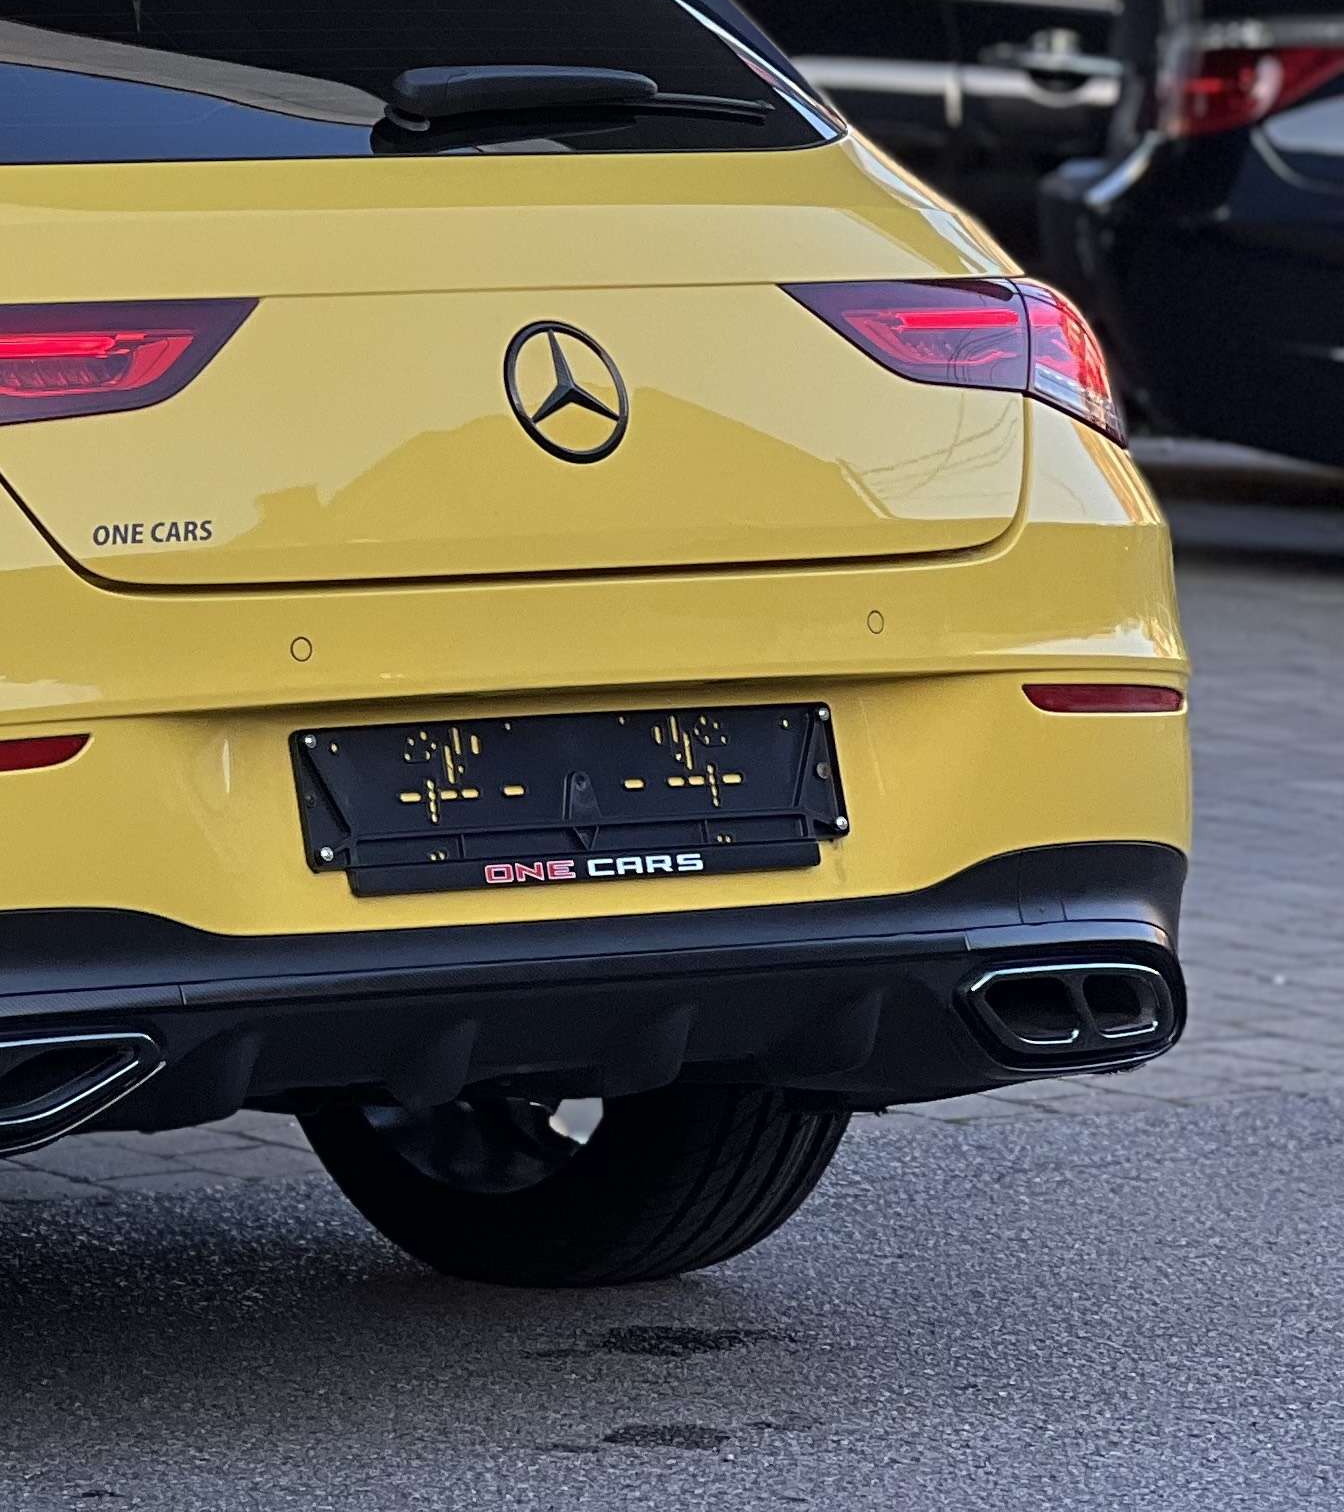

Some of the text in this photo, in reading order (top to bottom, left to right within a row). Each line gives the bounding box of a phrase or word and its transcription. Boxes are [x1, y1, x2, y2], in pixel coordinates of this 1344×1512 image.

[92, 520, 212, 546] ONE CARS
[484, 853, 704, 884] ONE CARS
